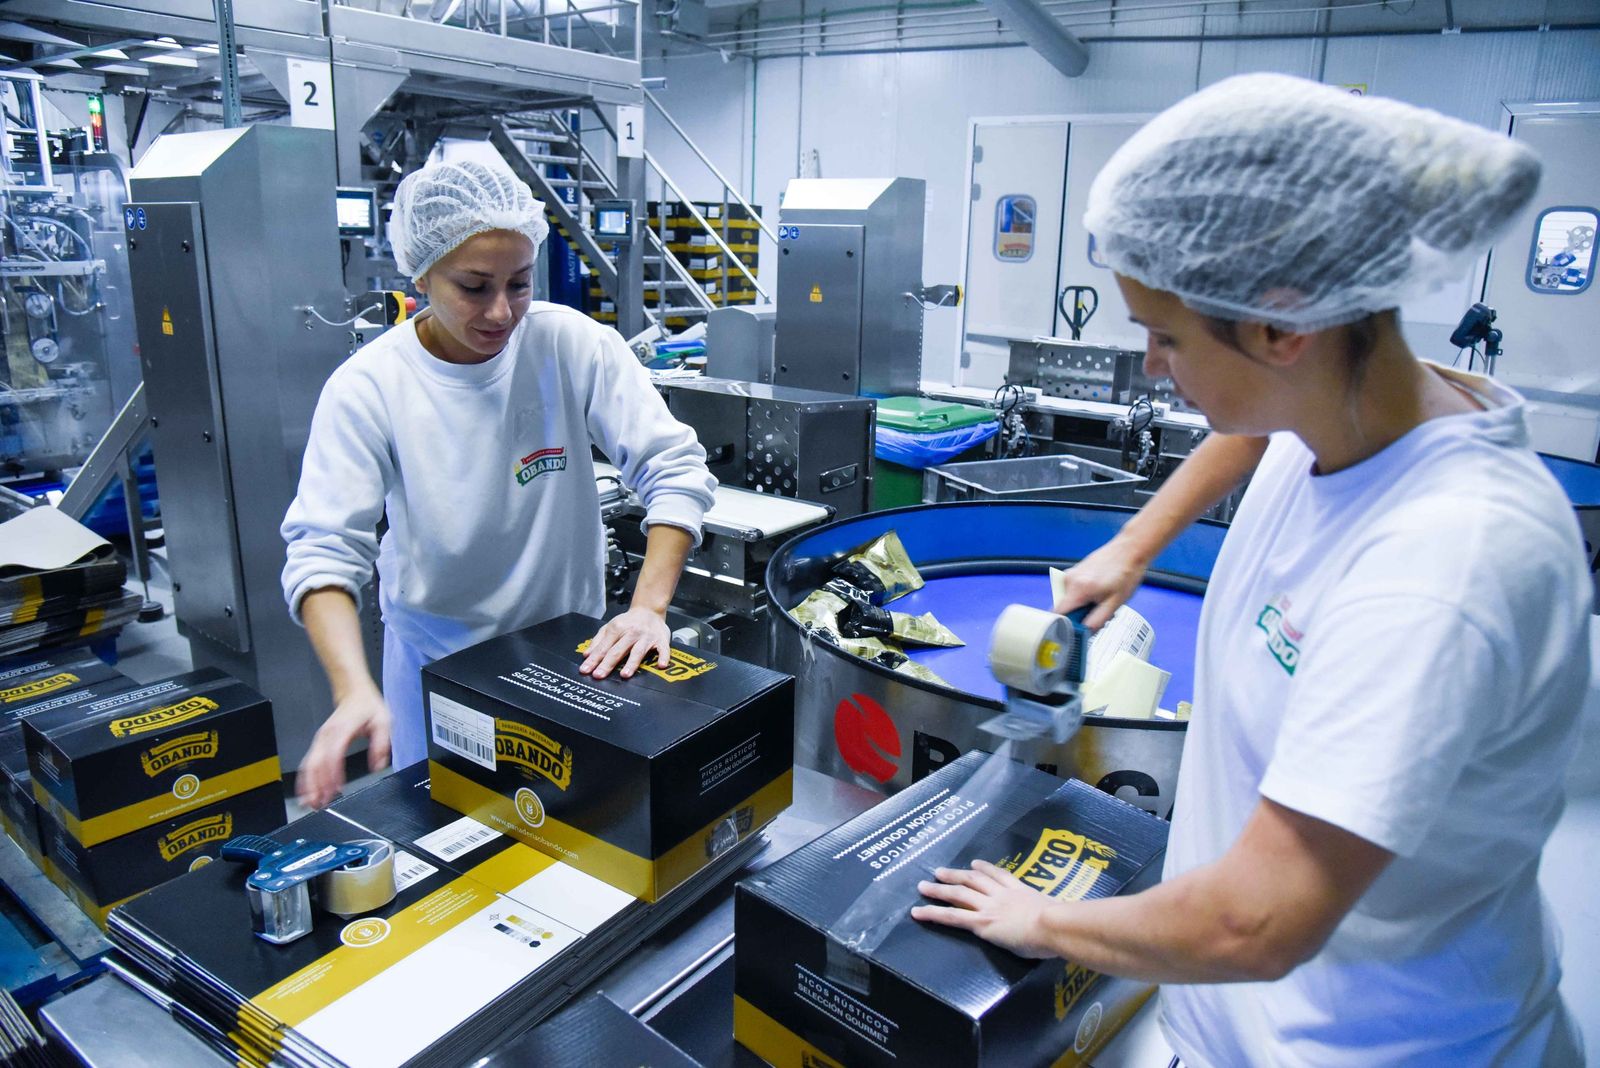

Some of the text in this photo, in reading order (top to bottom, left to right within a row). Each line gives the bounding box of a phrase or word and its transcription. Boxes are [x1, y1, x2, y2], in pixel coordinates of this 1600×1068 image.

[303, 81, 319, 106] 2
[626, 121, 635, 140] 1
[521, 457, 566, 482] OBANDO
[511, 671, 614, 713] SELECCIÓN GOURMET
[522, 666, 624, 709] PICOS RÚSTICOS
[119, 700, 202, 729] OBANDO
[150, 743, 212, 771] OBANDO
[496, 738, 563, 780] OBANDO
[701, 761, 723, 779] PICOS
[732, 750, 757, 770] GOURMET
[936, 799, 975, 825] PICOS
[167, 825, 226, 856] OBANDO
[856, 794, 961, 862] SELECCIÓN GOURMET
[798, 972, 829, 997] PICOS
[798, 983, 888, 1044] SELECCIÓN GOURMET
